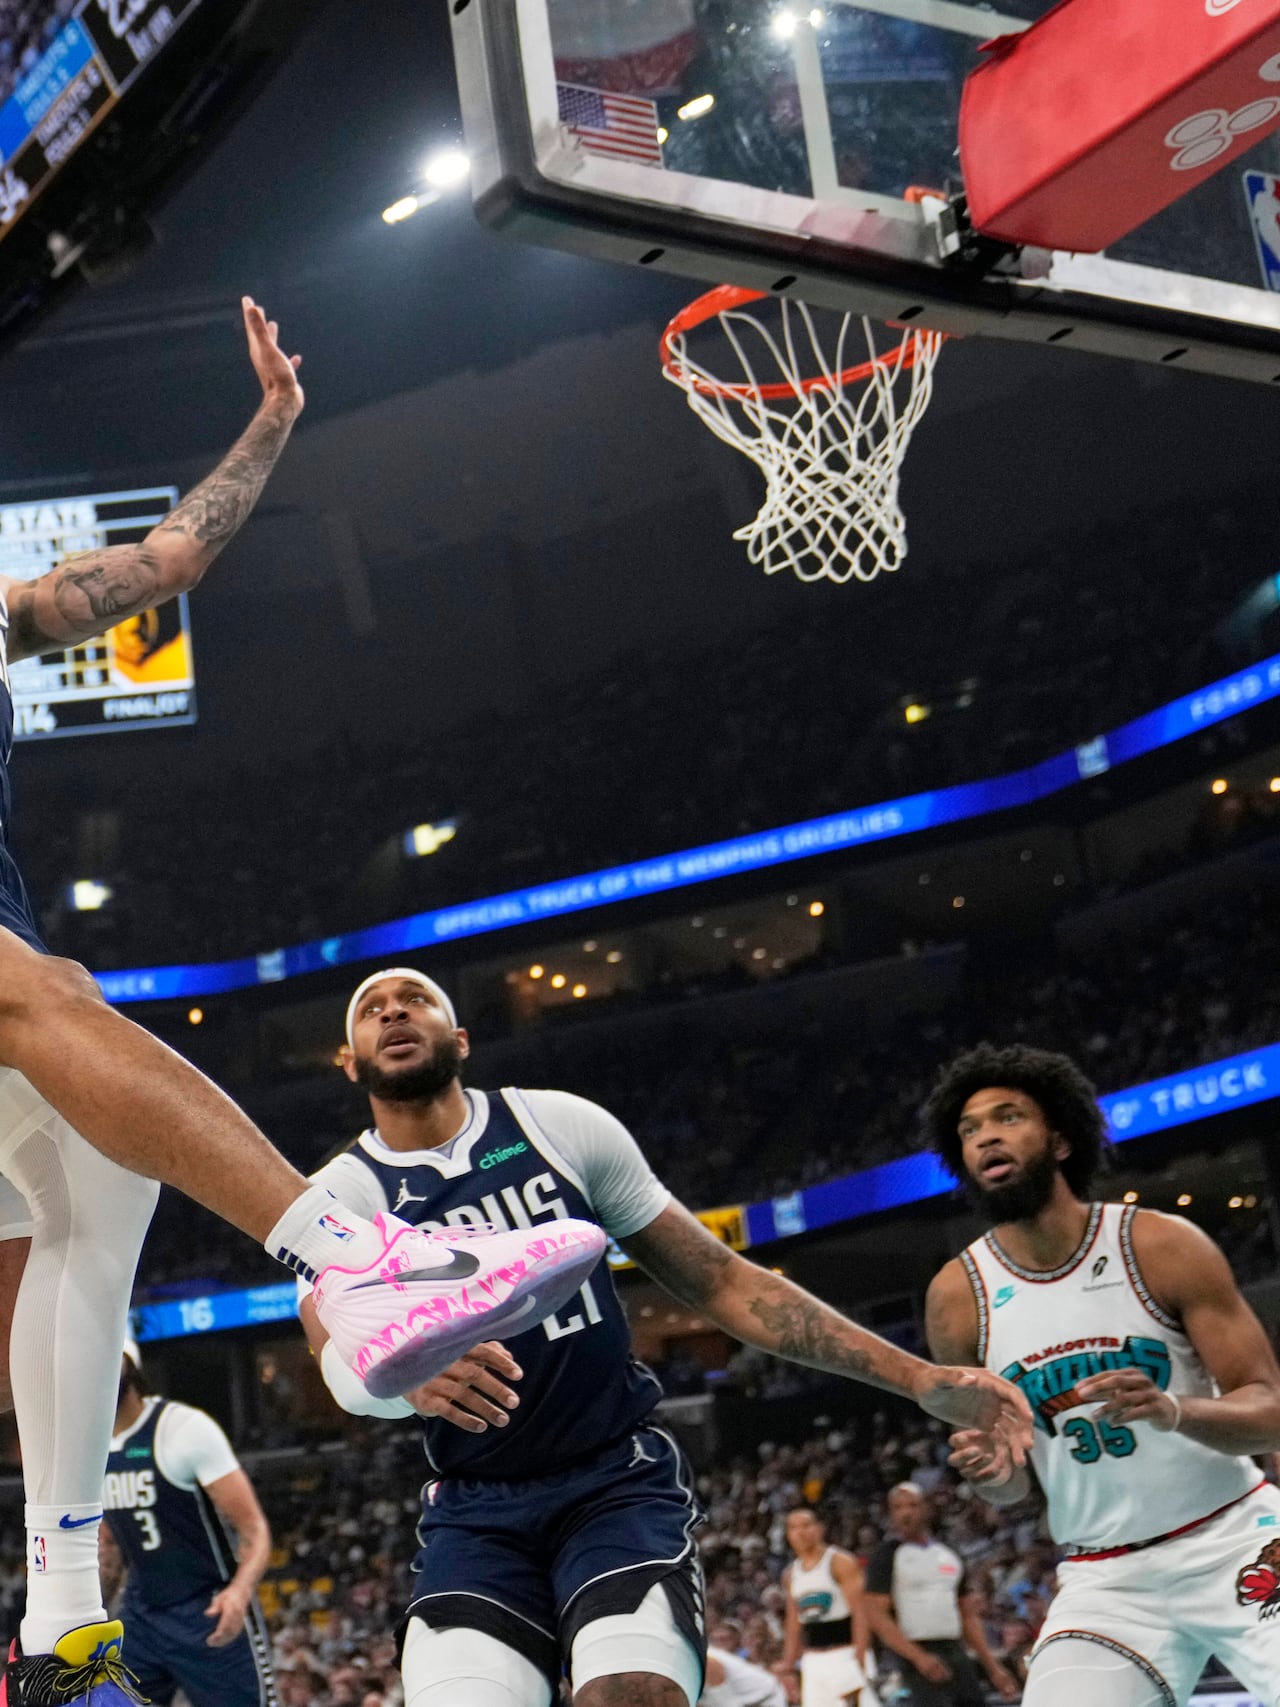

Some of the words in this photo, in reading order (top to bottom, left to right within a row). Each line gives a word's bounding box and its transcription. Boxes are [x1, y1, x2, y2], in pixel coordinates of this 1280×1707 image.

[434, 902, 523, 936] OFFICIAL
[528, 882, 595, 912] TRUCK
[598, 872, 627, 897] OF
[631, 862, 674, 888] THE
[677, 835, 780, 877] MEMPHIS
[783, 808, 904, 854] GRIZZLIES
[1150, 1061, 1267, 1117] TRUCK
[478, 1141, 527, 1170] chime
[178, 1297, 215, 1332] 16
[1023, 1337, 1120, 1365] VANCOUVER
[1063, 1416, 1138, 1464] 35
[134, 1511, 161, 1551] 3
